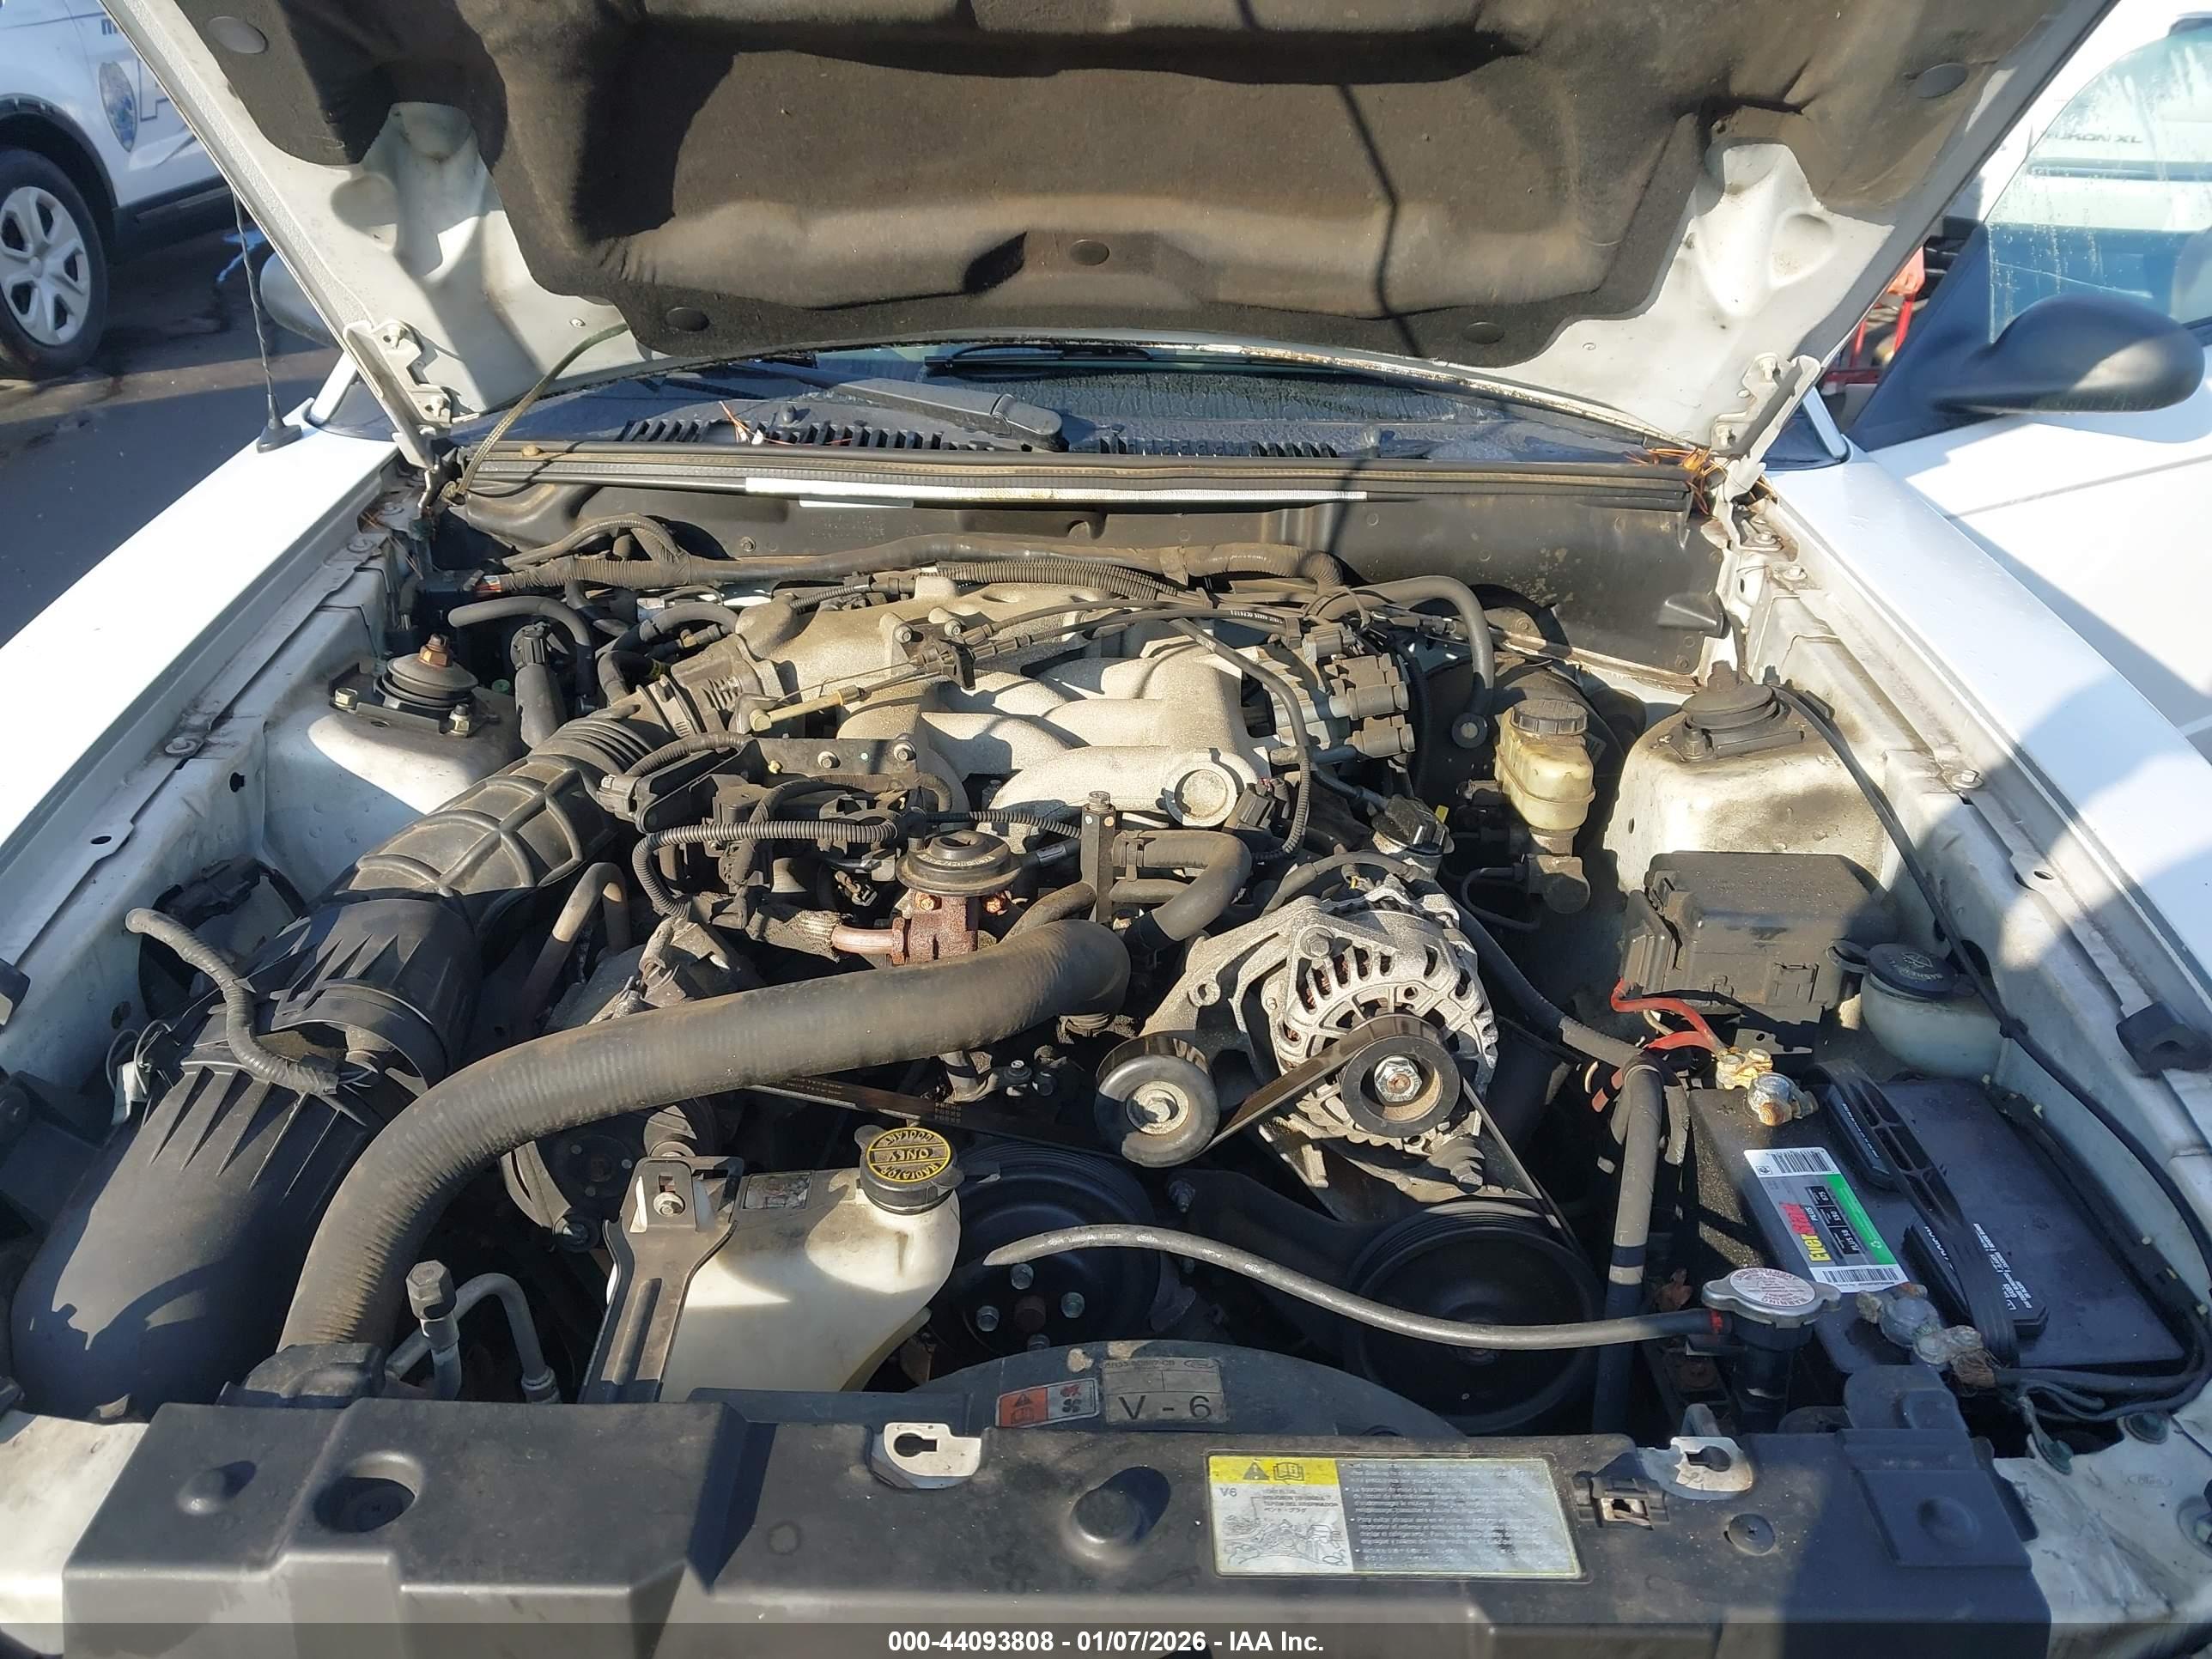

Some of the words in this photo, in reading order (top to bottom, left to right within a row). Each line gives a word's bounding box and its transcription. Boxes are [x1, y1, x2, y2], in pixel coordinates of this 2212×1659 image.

[890, 1149, 931, 1162] ONLY
[881, 1163, 939, 1180] RADIATOR
[1805, 1206, 1818, 1221] PLUS
[1219, 1487, 1237, 1497] V6
